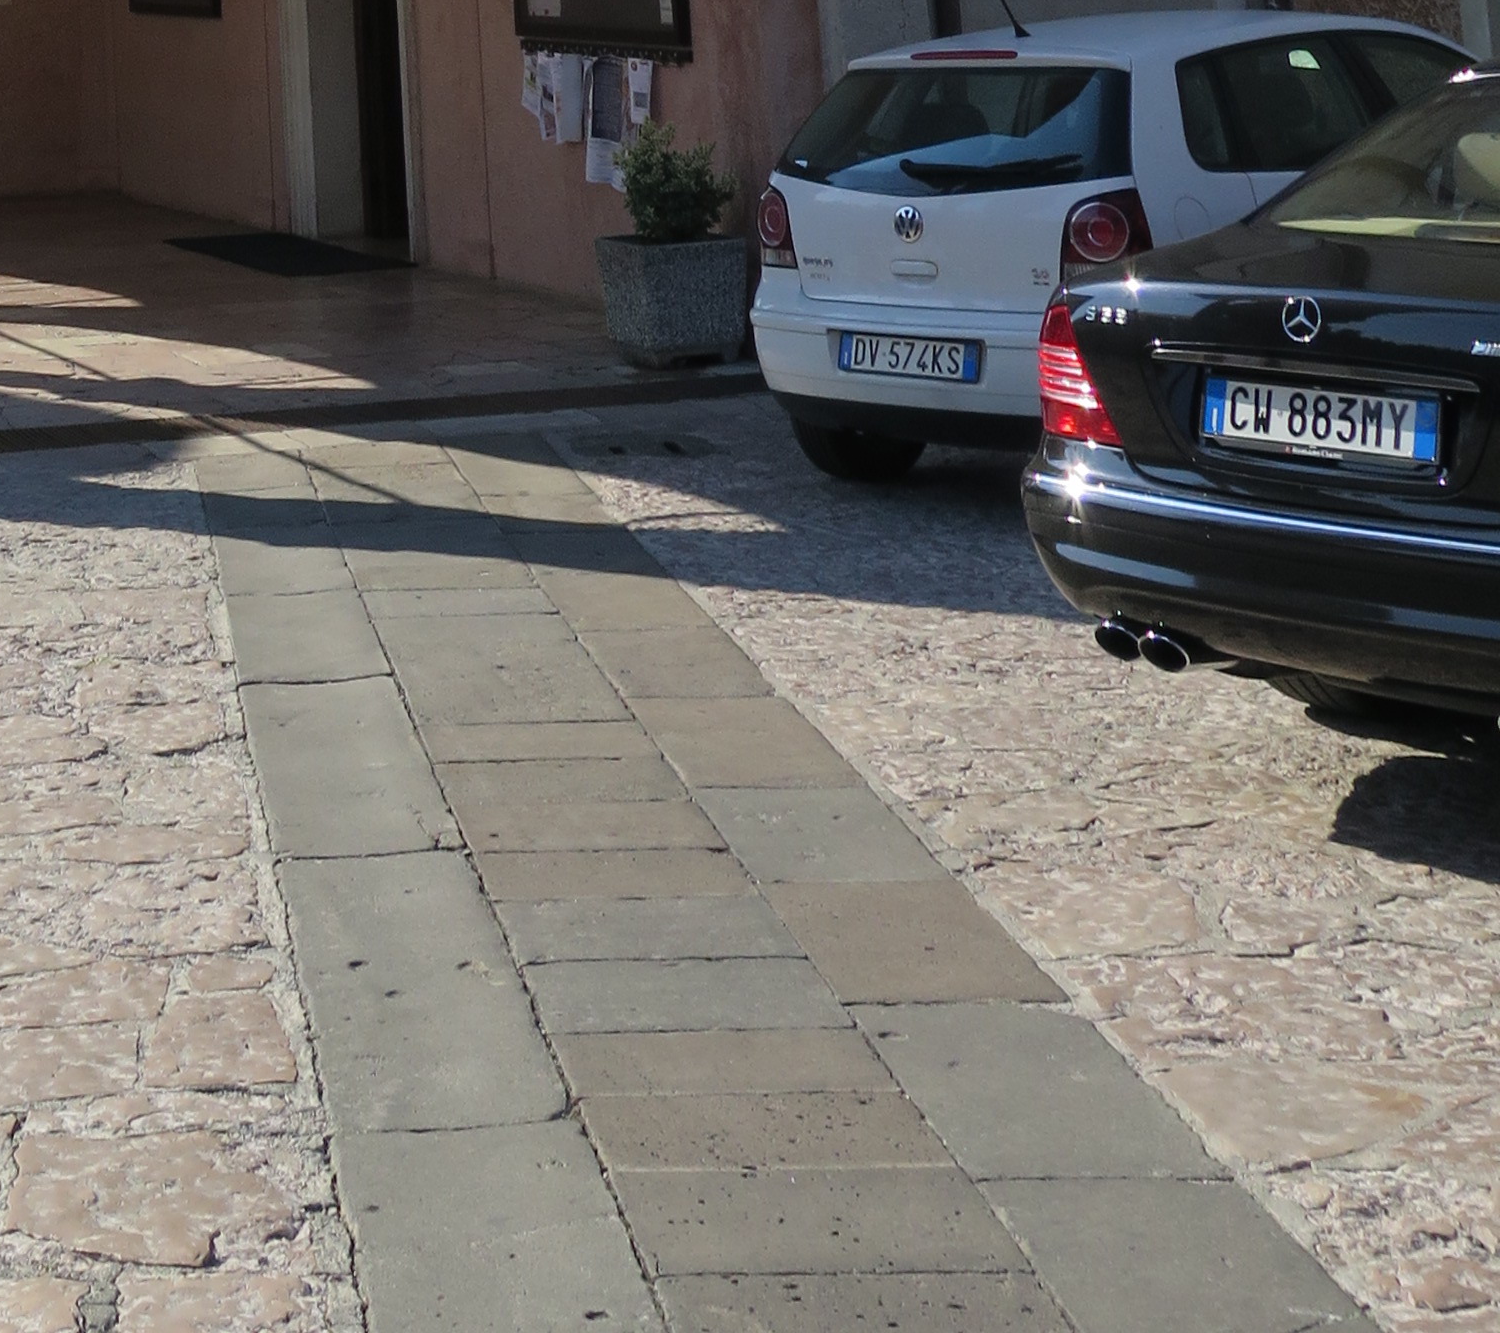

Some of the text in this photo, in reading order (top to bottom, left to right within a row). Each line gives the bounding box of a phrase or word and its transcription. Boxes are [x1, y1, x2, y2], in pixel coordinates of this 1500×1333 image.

[853, 338, 961, 375] DV 574KS
[1229, 386, 1409, 450] CW 883MY
